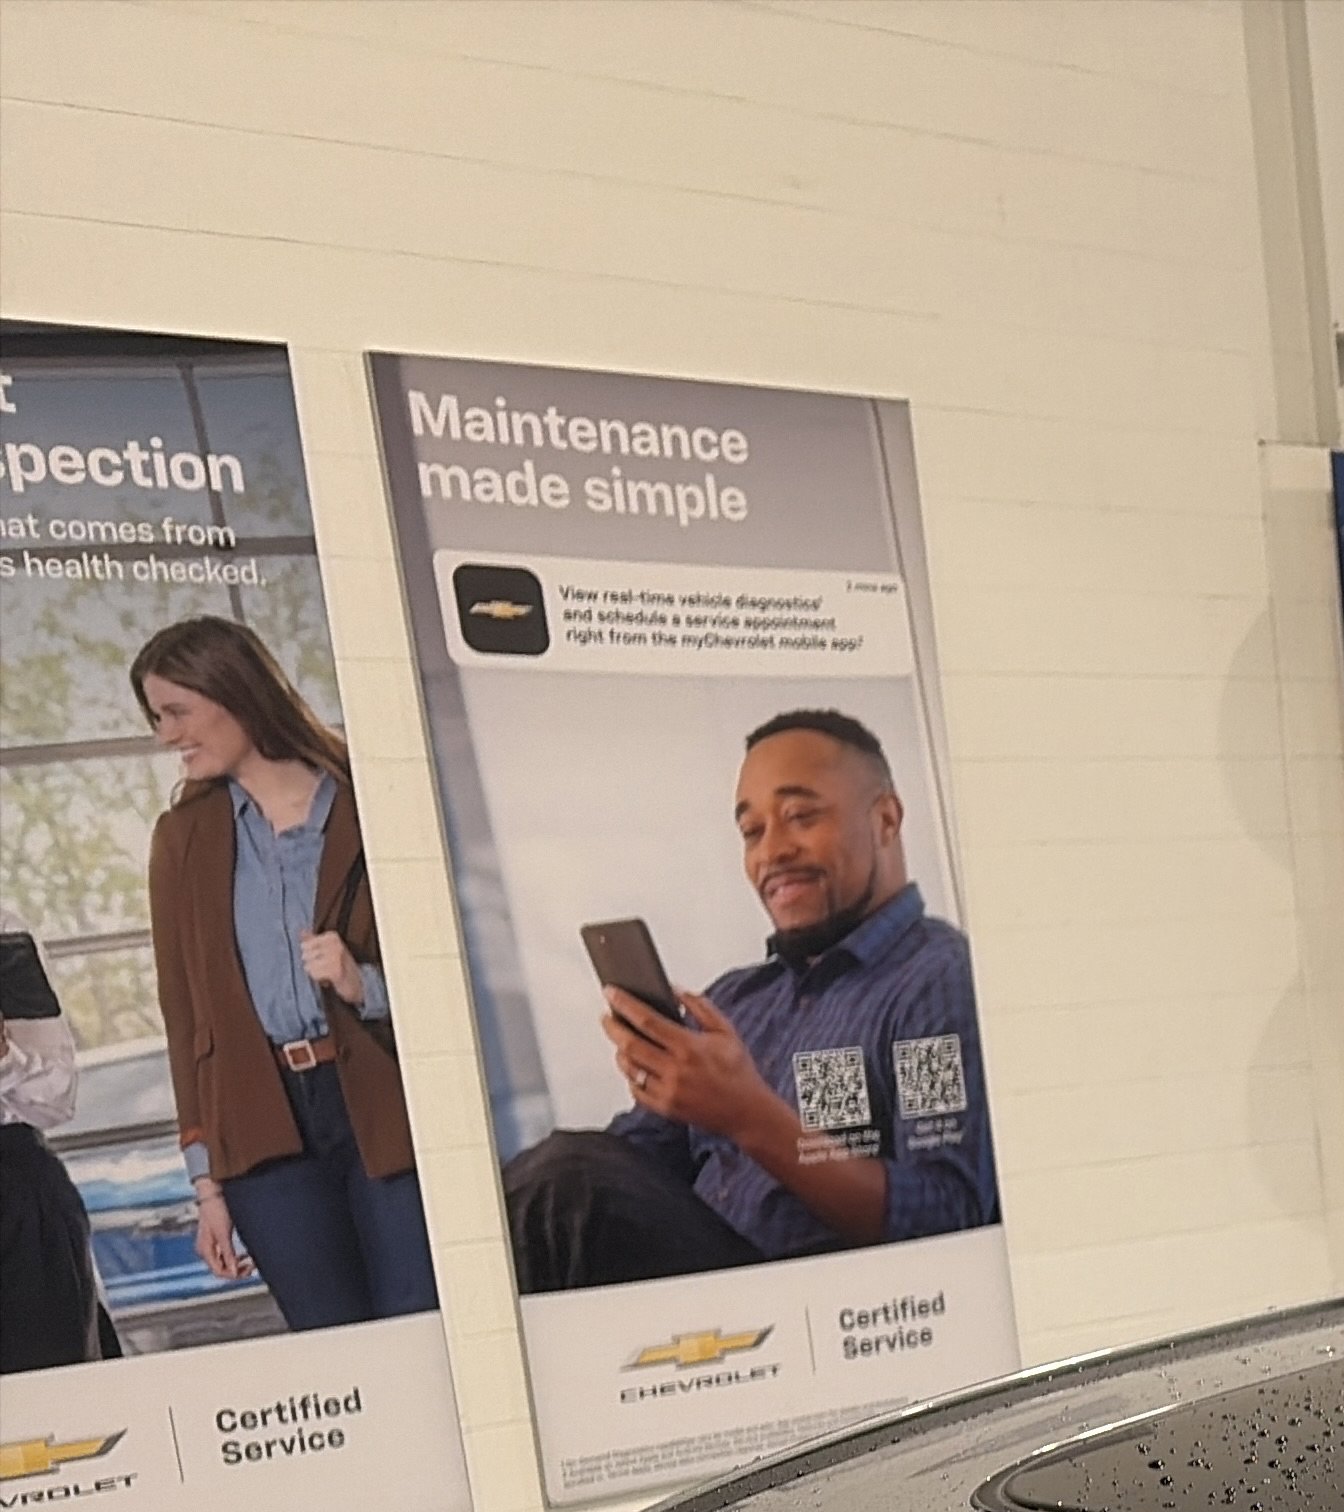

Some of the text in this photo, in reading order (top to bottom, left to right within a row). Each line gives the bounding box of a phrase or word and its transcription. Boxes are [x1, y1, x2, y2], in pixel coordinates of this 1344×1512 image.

[408, 389, 750, 464] Maintenance
[0, 436, 246, 494] pection
[418, 458, 749, 527] made simple
[49, 517, 154, 543] comes
[161, 516, 236, 548] from
[23, 549, 124, 581] health
[132, 553, 267, 587] checked.
[558, 583, 599, 602] View
[678, 591, 732, 610] vehicle
[563, 606, 836, 632] and schedule a service appointment
[566, 626, 604, 646] right
[609, 627, 647, 646] from
[652, 629, 677, 647] the
[778, 633, 827, 650] mobile
[839, 1290, 945, 1331] Certified
[843, 1325, 933, 1360] Service
[620, 1363, 781, 1403] CHEVROLET
[215, 1387, 363, 1433] Certified
[221, 1427, 346, 1465] Service
